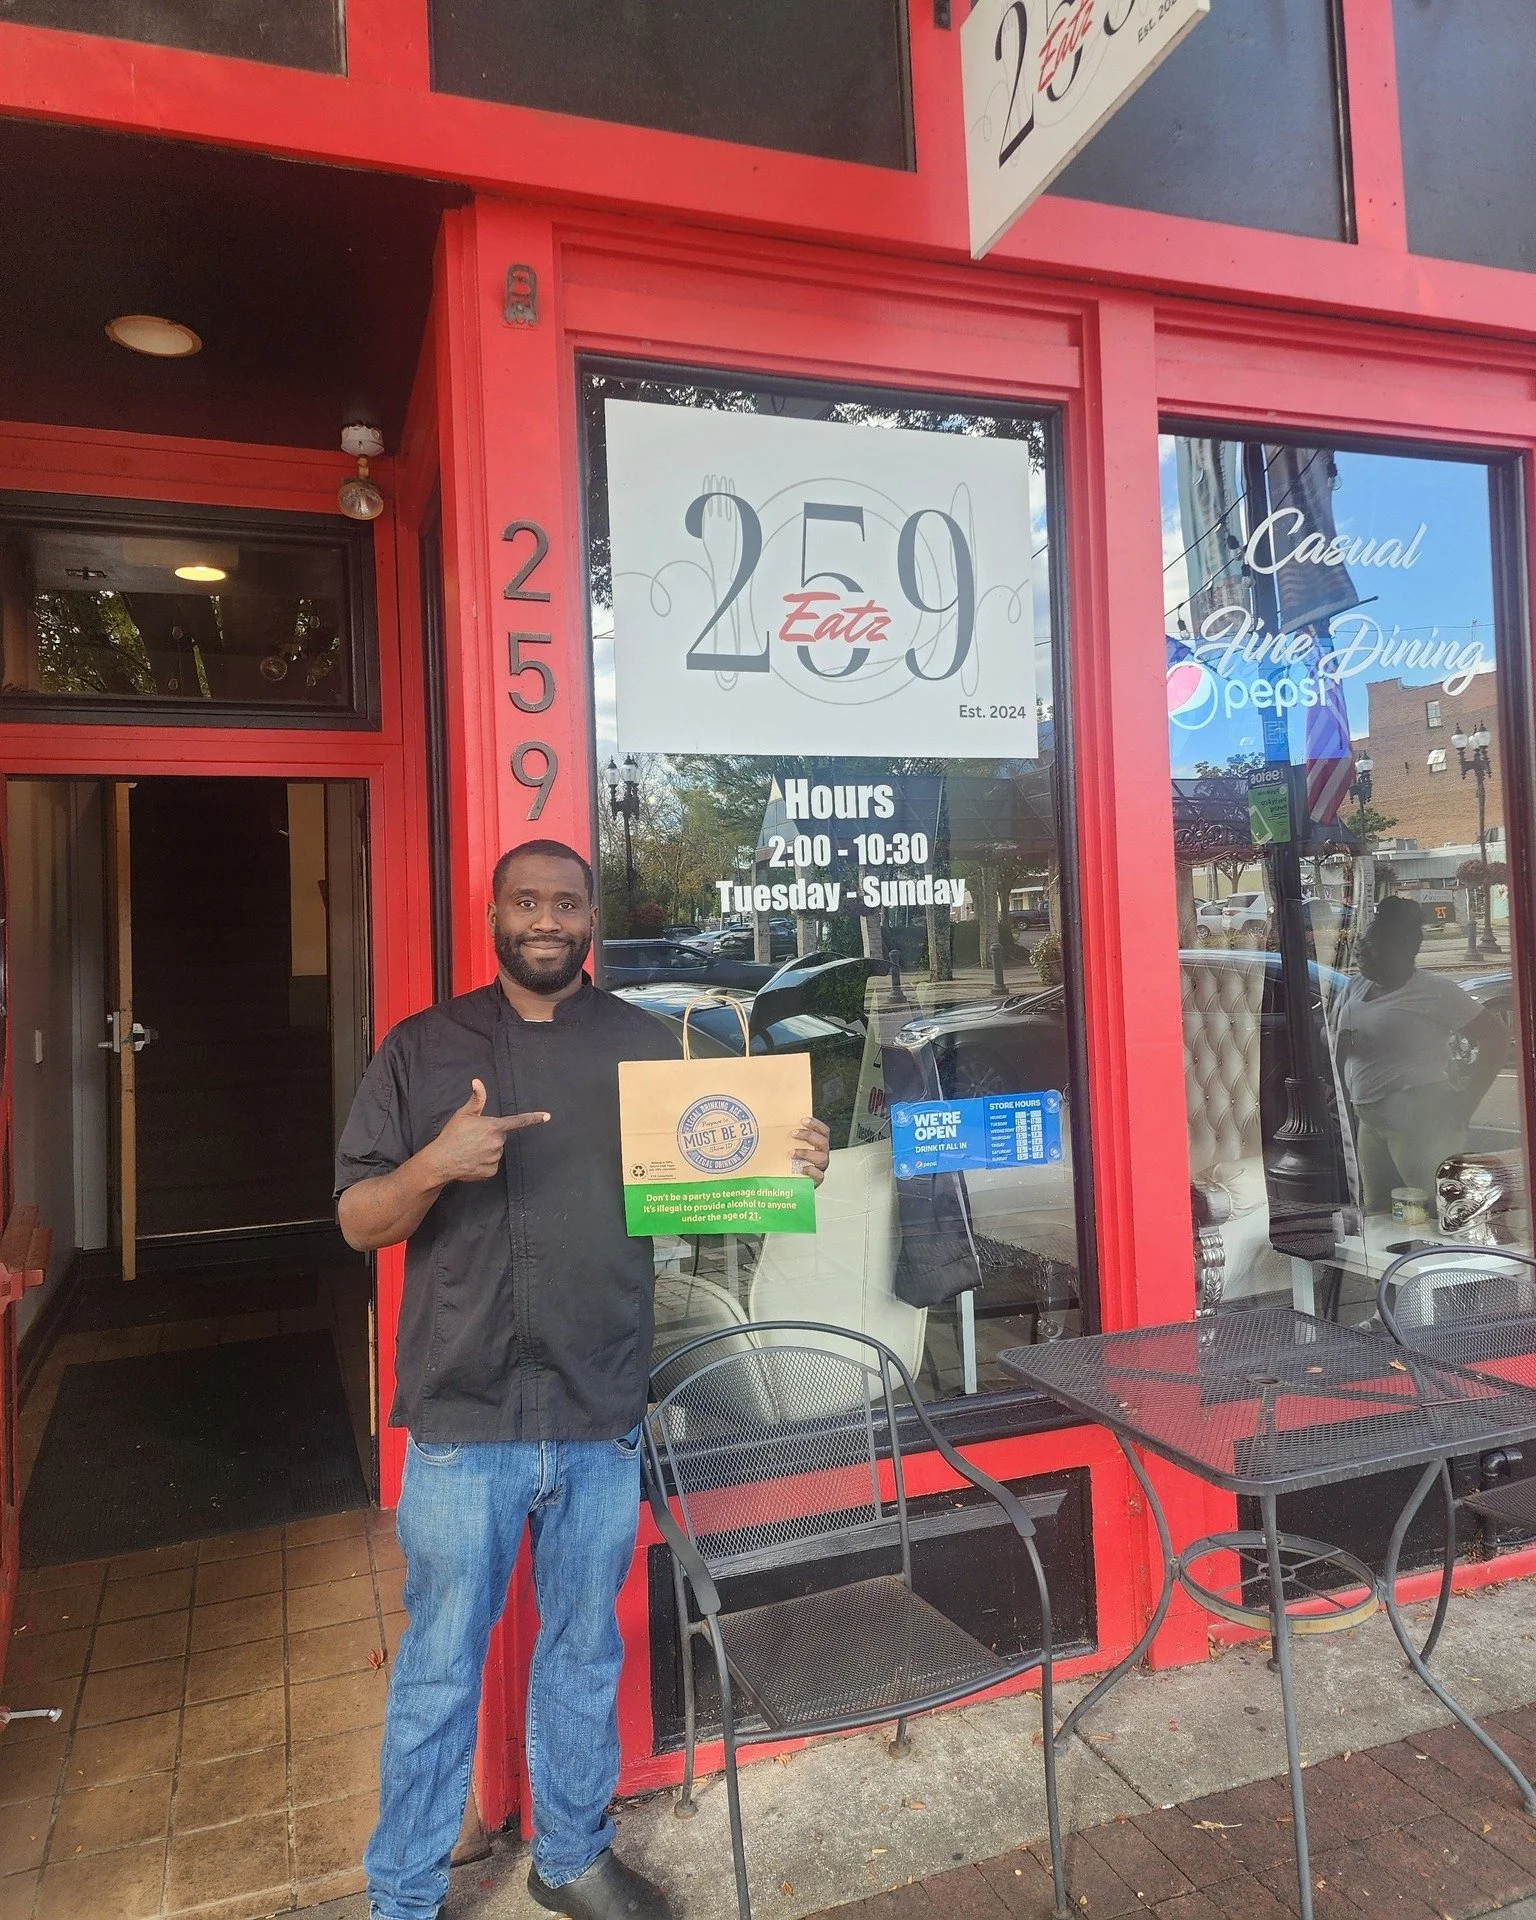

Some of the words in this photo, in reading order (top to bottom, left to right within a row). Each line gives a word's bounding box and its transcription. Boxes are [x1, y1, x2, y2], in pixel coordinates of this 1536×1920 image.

[1246, 507, 1428, 575] Casual
[684, 491, 976, 682] 259
[778, 591, 894, 644] Eatz
[1193, 605, 1316, 677] Fine
[1318, 613, 1486, 696] Dining
[501, 519, 559, 822] 259
[1225, 676, 1327, 719] pepsi
[959, 704, 987, 719] Est.
[989, 704, 1027, 720] 2024
[784, 778, 895, 820] Hours
[768, 834, 832, 868] 2:00
[853, 832, 929, 865] 10:30
[715, 879, 841, 913] Tuesday
[862, 874, 966, 908] Sunday
[686, 1110, 702, 1130] LEGAL
[700, 1101, 729, 1113] DRINKING
[729, 1104, 742, 1116] AGE
[913, 1111, 962, 1127] WE'RE
[989, 1101, 1014, 1111] STORE
[1014, 1099, 1041, 1108] HOURS
[683, 1129, 717, 1149] MUST
[721, 1125, 737, 1141] BE
[739, 1121, 754, 1136] 21
[914, 1124, 957, 1141] OPEN
[695, 1154, 713, 1168] LEGAL
[714, 1155, 742, 1169] DRINKING
[739, 1144, 751, 1157] AGE
[915, 1144, 939, 1153] DRINK
[938, 1143, 946, 1151] IT
[945, 1142, 959, 1151] ALL
[959, 1141, 967, 1149] IN
[923, 1160, 938, 1168] pepsi
[656, 1203, 682, 1214] illegal
[683, 1204, 692, 1212] to
[693, 1201, 726, 1213] provide
[726, 1200, 757, 1209] alcohol
[757, 1200, 766, 1208] to
[767, 1201, 797, 1211] anyone
[670, 1193, 681, 1201] be
[688, 1193, 711, 1203] party
[712, 1191, 721, 1199] to
[722, 1189, 756, 1199] teenage
[756, 1188, 794, 1199] drinking!
[681, 1214, 706, 1223] under
[707, 1212, 721, 1221] the
[722, 1212, 738, 1222] age
[739, 1211, 748, 1220] of
[748, 1211, 762, 1222] 21.
